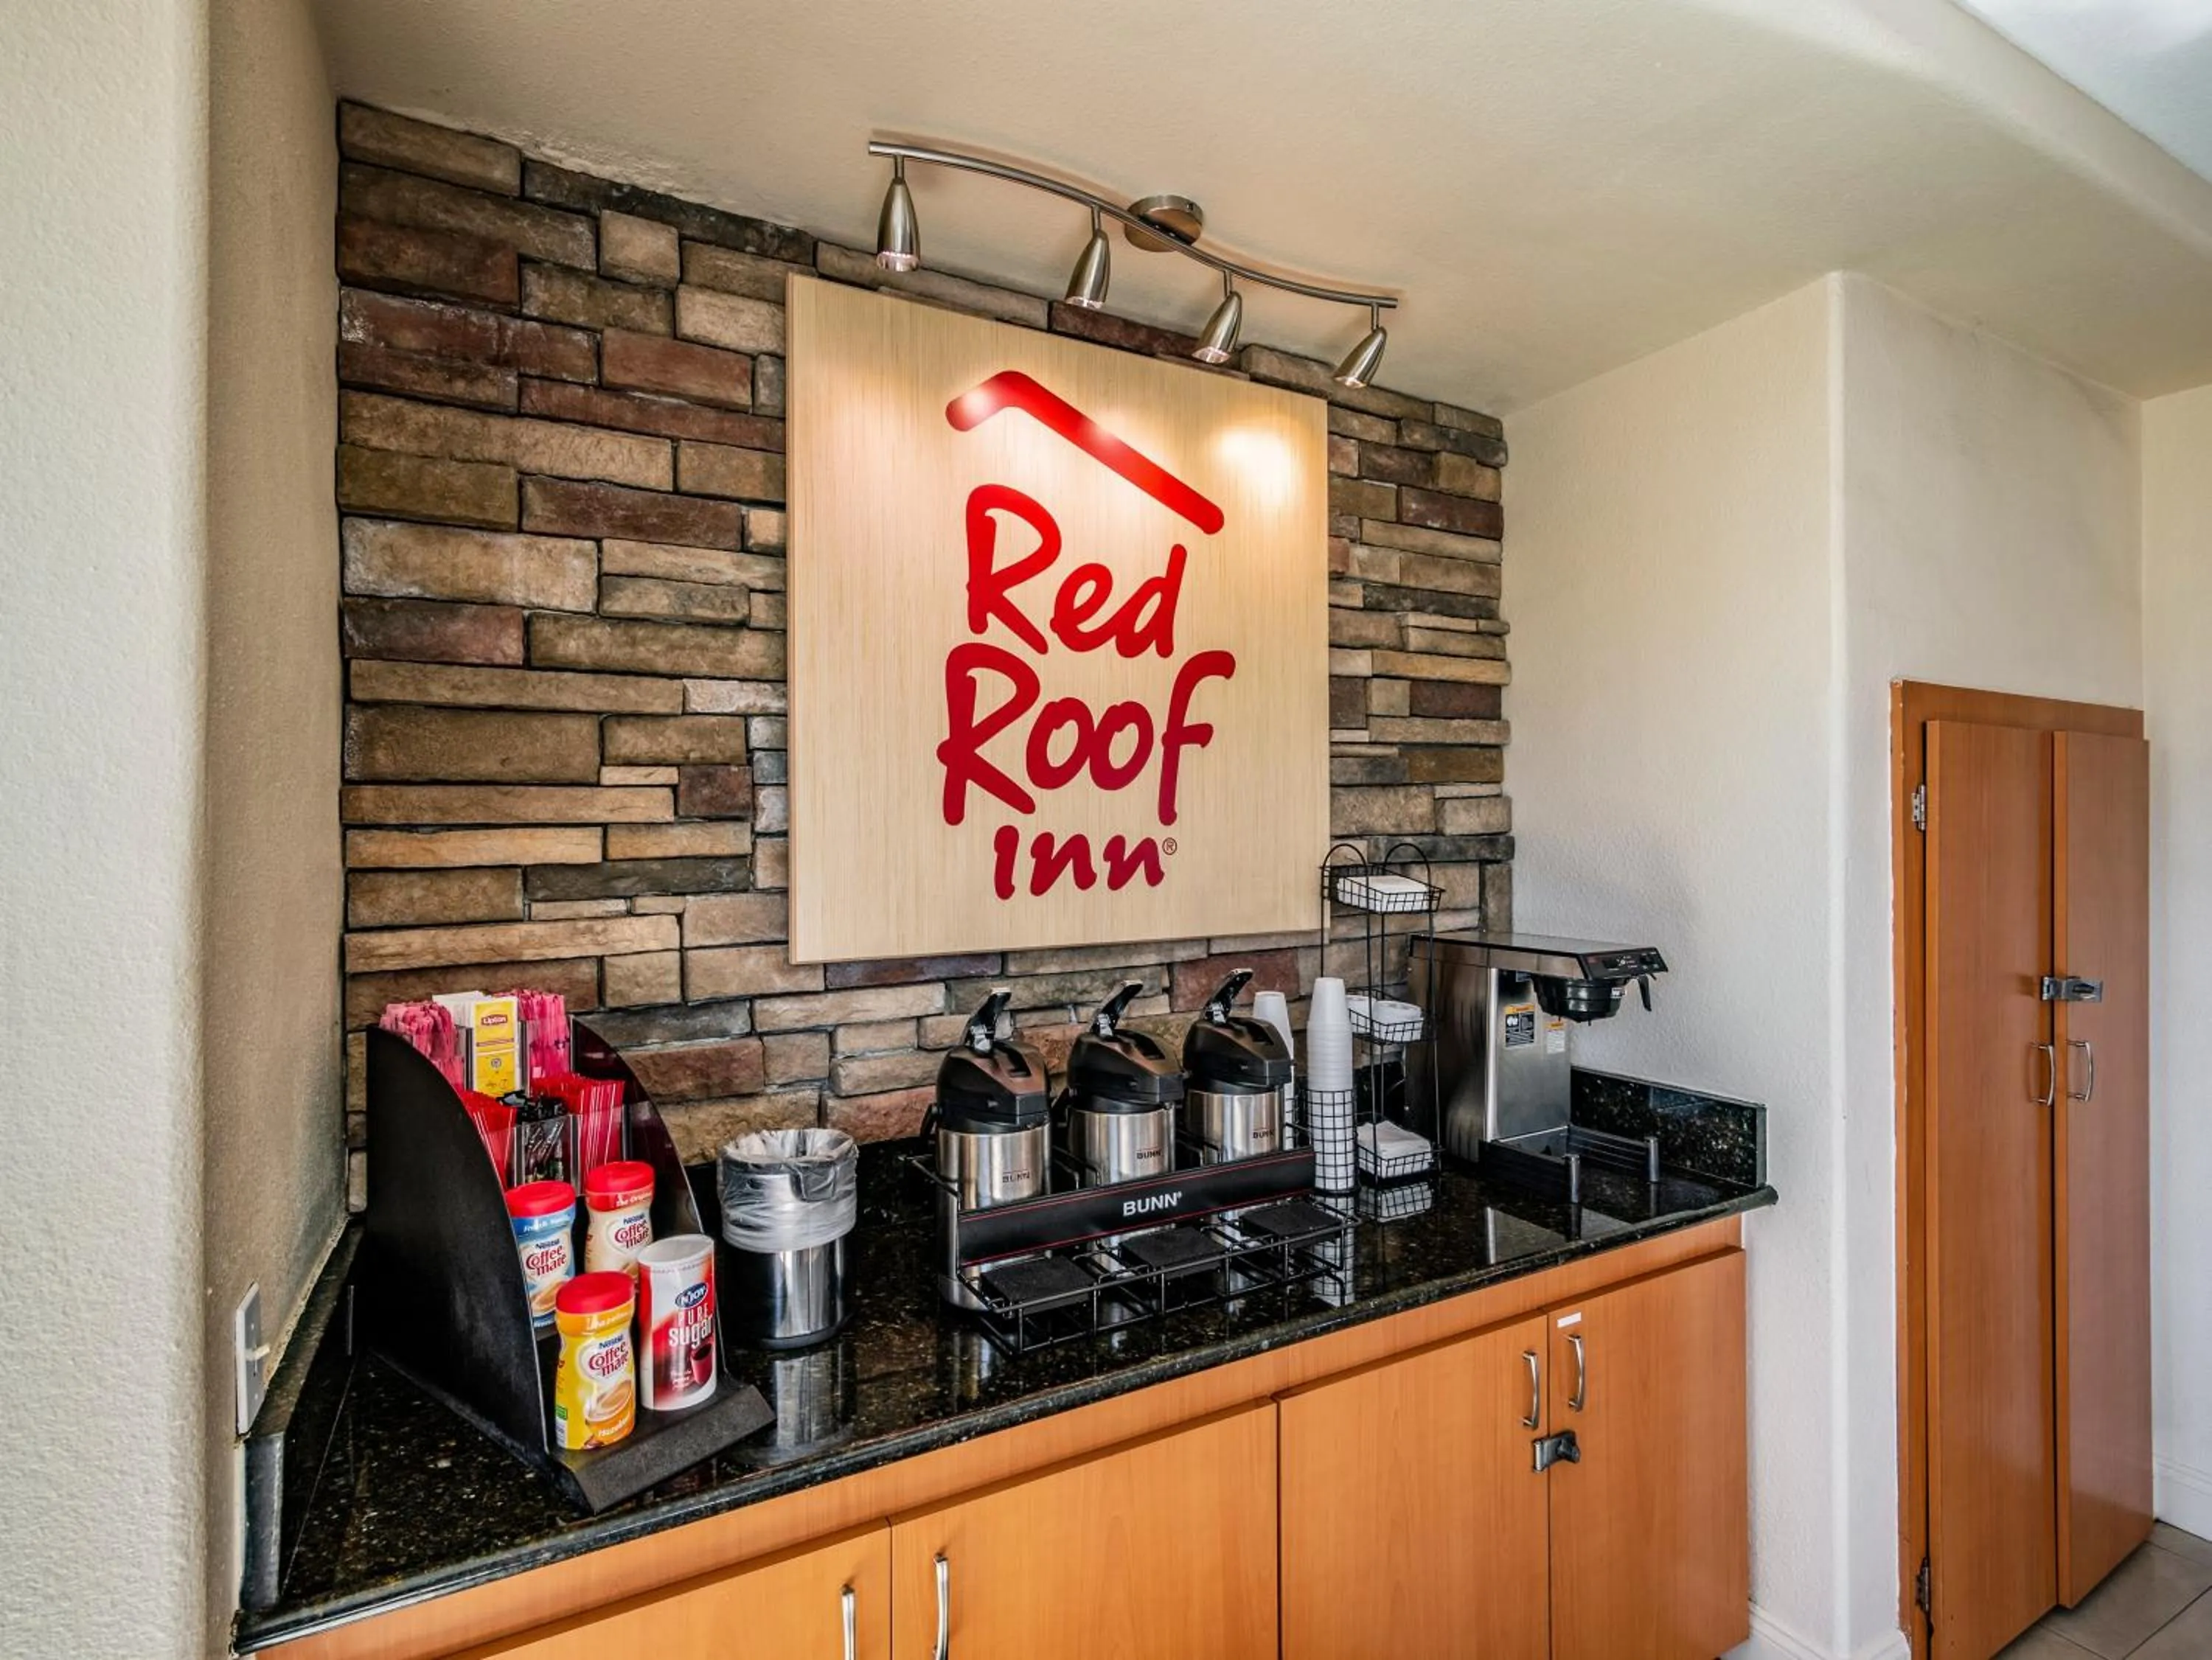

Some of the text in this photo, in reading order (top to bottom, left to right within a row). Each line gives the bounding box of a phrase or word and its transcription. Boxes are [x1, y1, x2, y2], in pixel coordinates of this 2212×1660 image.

[966, 484, 1187, 658] Red
[936, 643, 1236, 826] Roof
[483, 1016, 507, 1025] Lipton
[1136, 1149, 1161, 1159] BUNN
[1123, 1193, 1178, 1216] BUNN
[614, 1219, 647, 1244] Coffee
[526, 1245, 563, 1270] Coffee
[536, 1253, 566, 1276] mate
[669, 1314, 713, 1350] sugar
[588, 1341, 627, 1371] Coffee
[601, 1350, 629, 1377] mate
